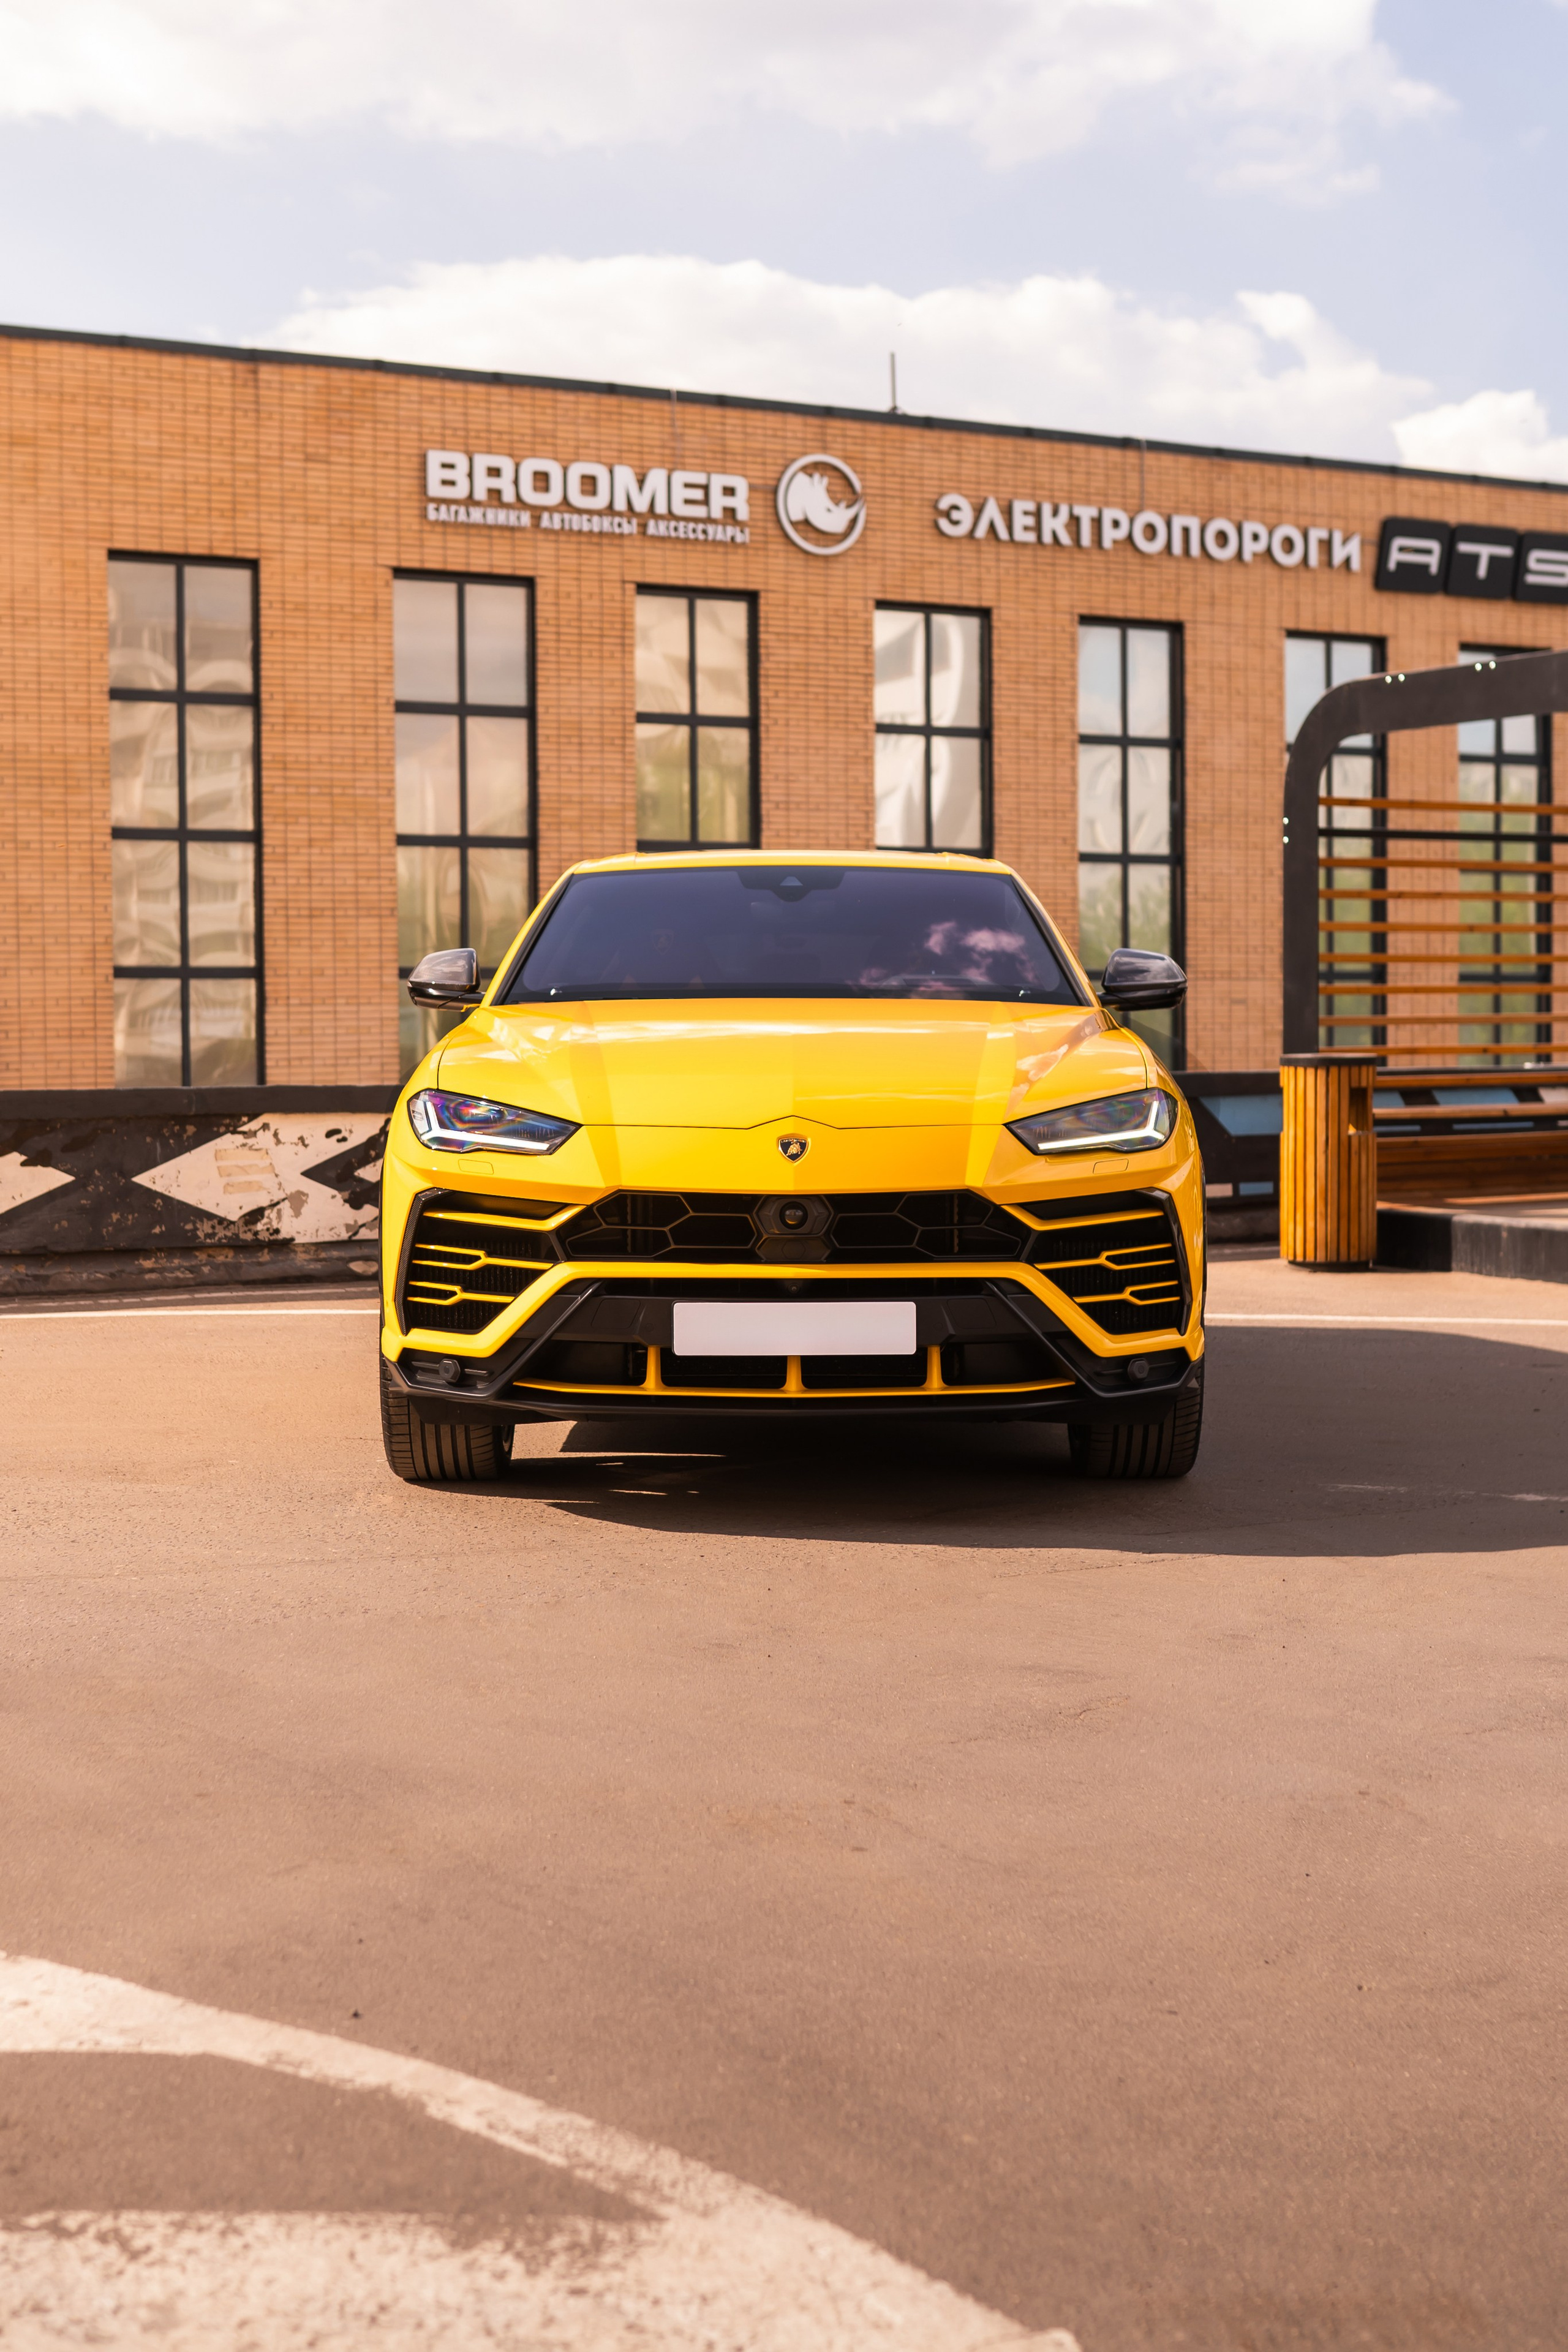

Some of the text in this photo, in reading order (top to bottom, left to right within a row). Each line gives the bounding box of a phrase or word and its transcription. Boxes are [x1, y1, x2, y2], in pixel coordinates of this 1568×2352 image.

[426, 449, 750, 521] BROOMER
[427, 502, 750, 544] БАГАЖНИКИ АВТОБОКСЫ АКСЕССУАРЫ
[935, 493, 1360, 573] ЭЛЕКТРОПОРОГИ
[1387, 536, 1568, 586] ATS
